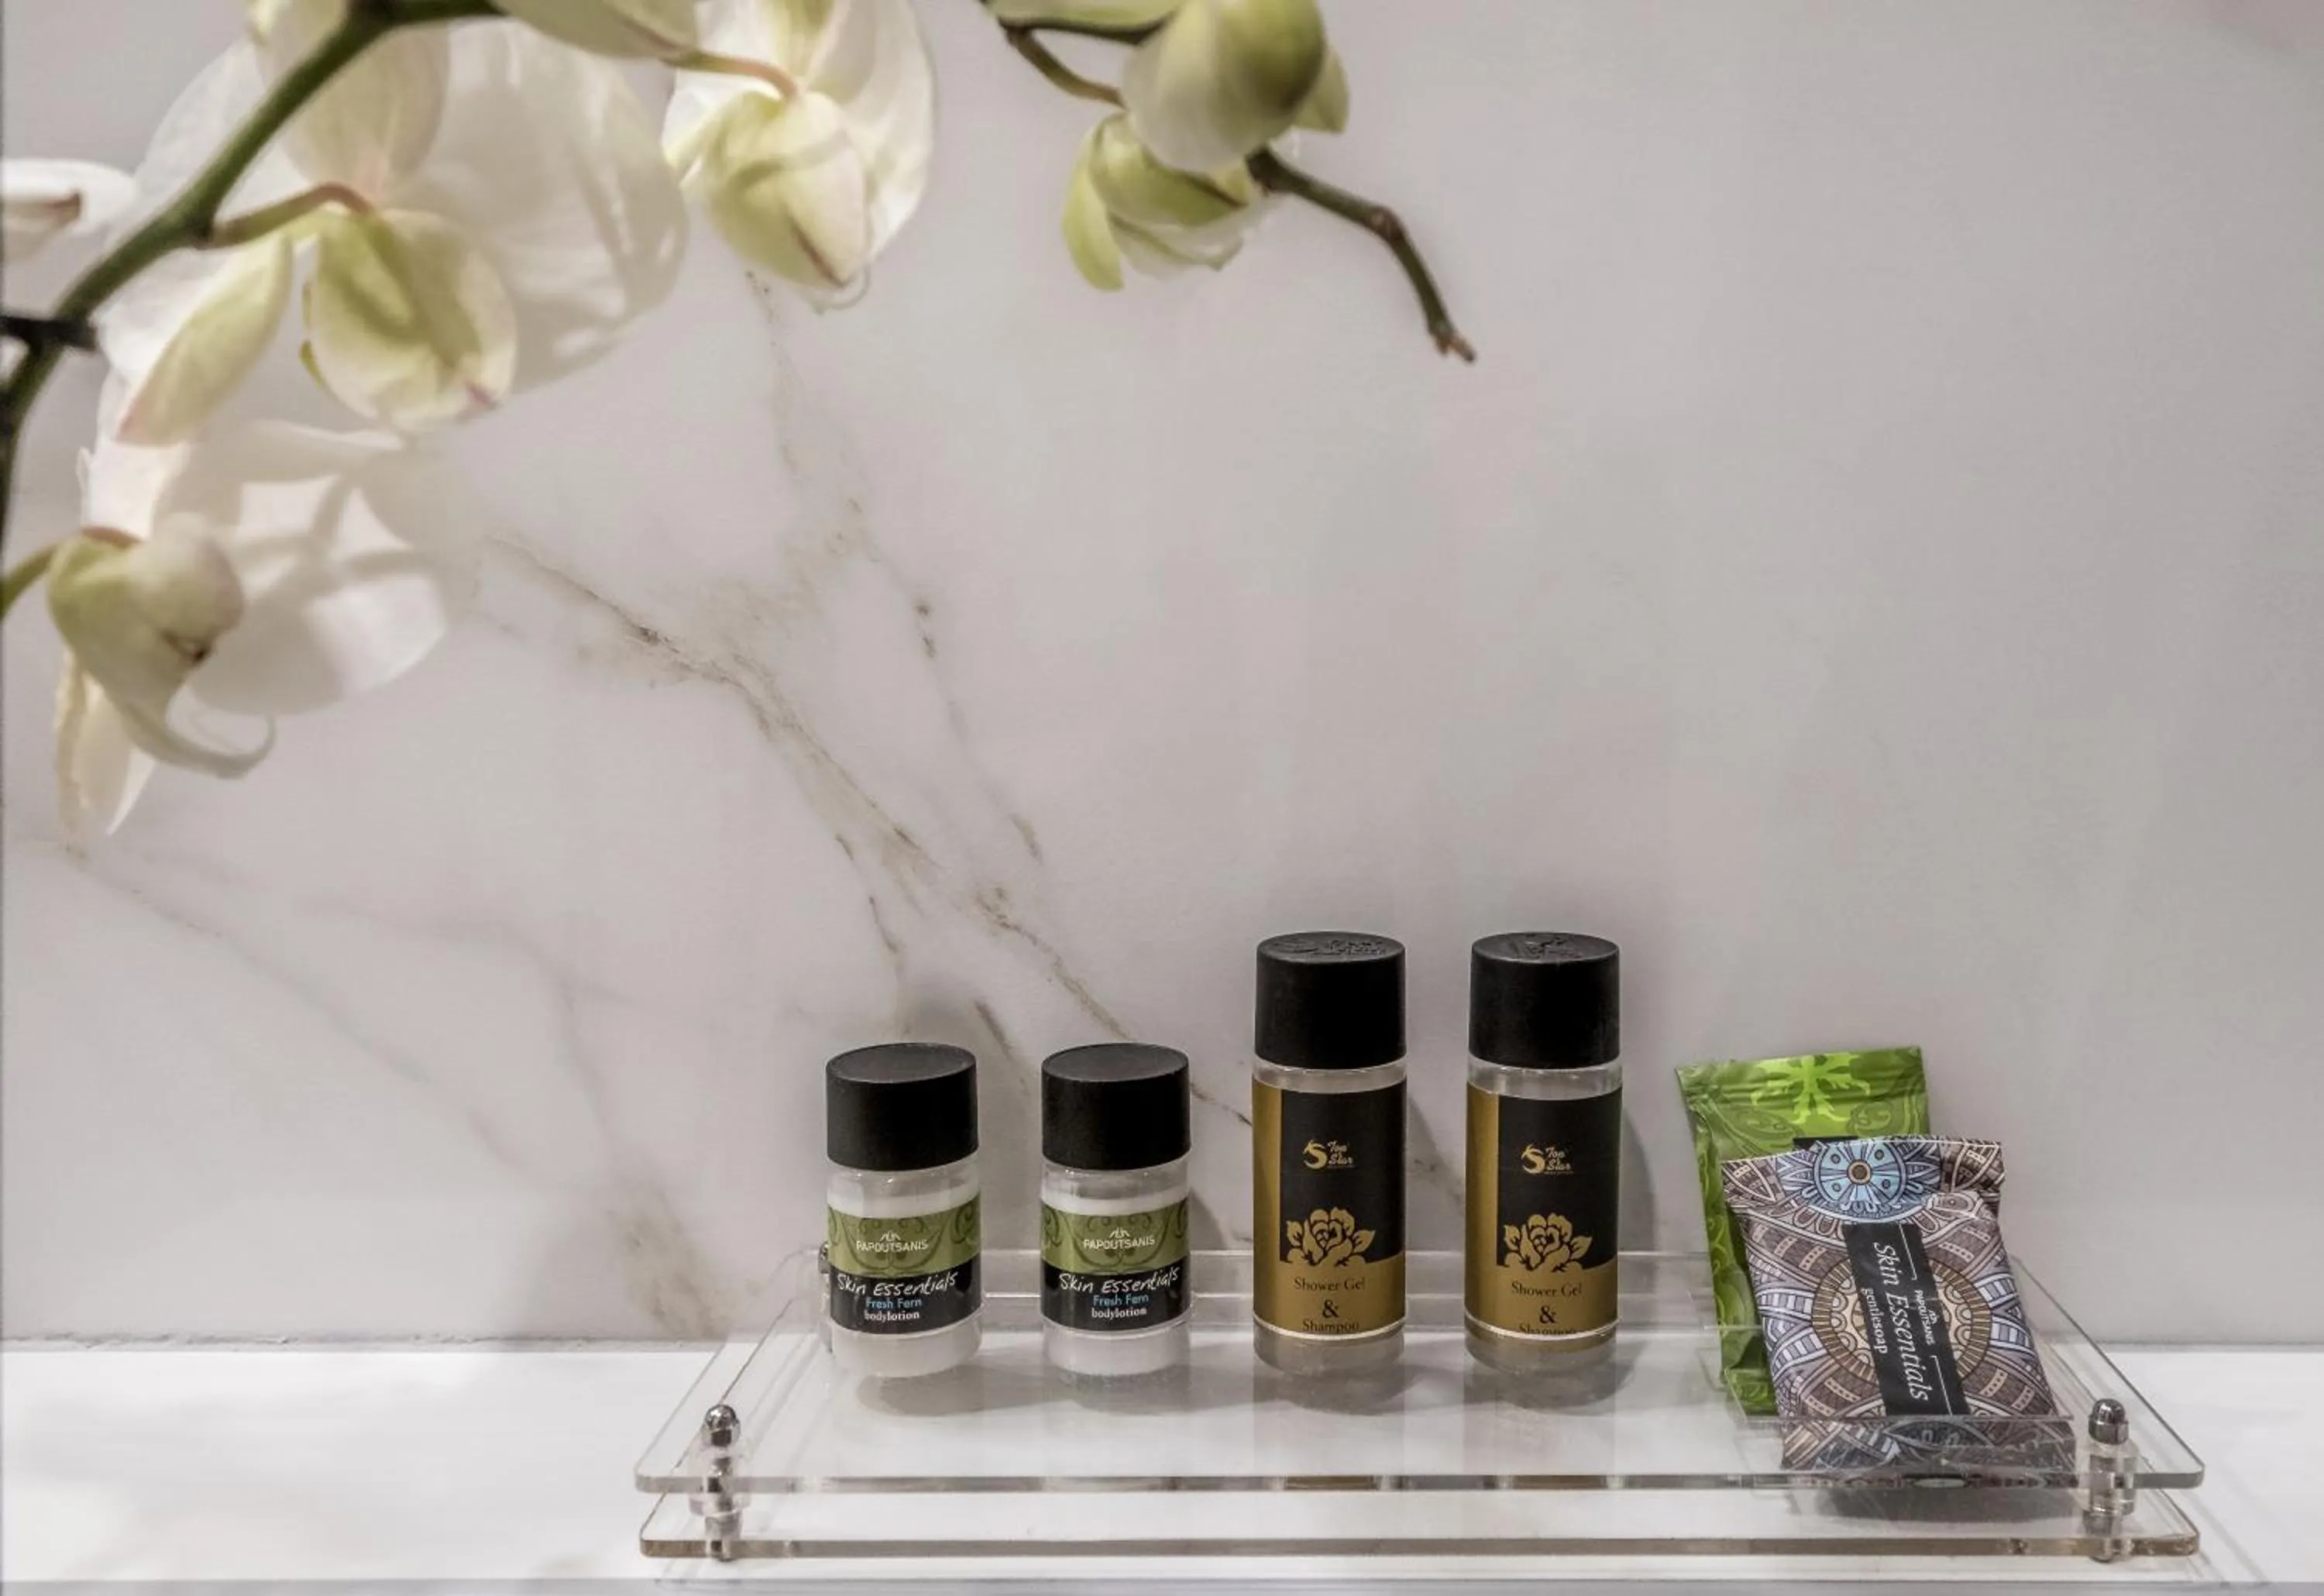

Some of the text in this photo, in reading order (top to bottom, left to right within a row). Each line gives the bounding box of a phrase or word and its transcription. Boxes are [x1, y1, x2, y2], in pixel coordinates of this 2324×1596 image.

[856, 1240, 929, 1253] PAPOUTSANIS
[1084, 1236, 1156, 1250] PAPOUTSANIS
[837, 1271, 958, 1296] Skin Essentials
[1059, 1267, 1181, 1293] Skin Essentials
[1294, 1276, 1365, 1292] Shower Gel
[1511, 1281, 1583, 1297] Shower Gel
[865, 1296, 923, 1309] Fresh Fern
[1093, 1294, 1149, 1305] Fresh Fern
[864, 1310, 920, 1323] bodylotion
[1092, 1307, 1147, 1320] bodylotion
[1322, 1299, 1339, 1318] &
[1538, 1305, 1557, 1324] &
[1302, 1319, 1360, 1333] Shampoo
[1861, 1288, 1889, 1354] gentlesoap
[1872, 1241, 1933, 1402] Skin Essentials
